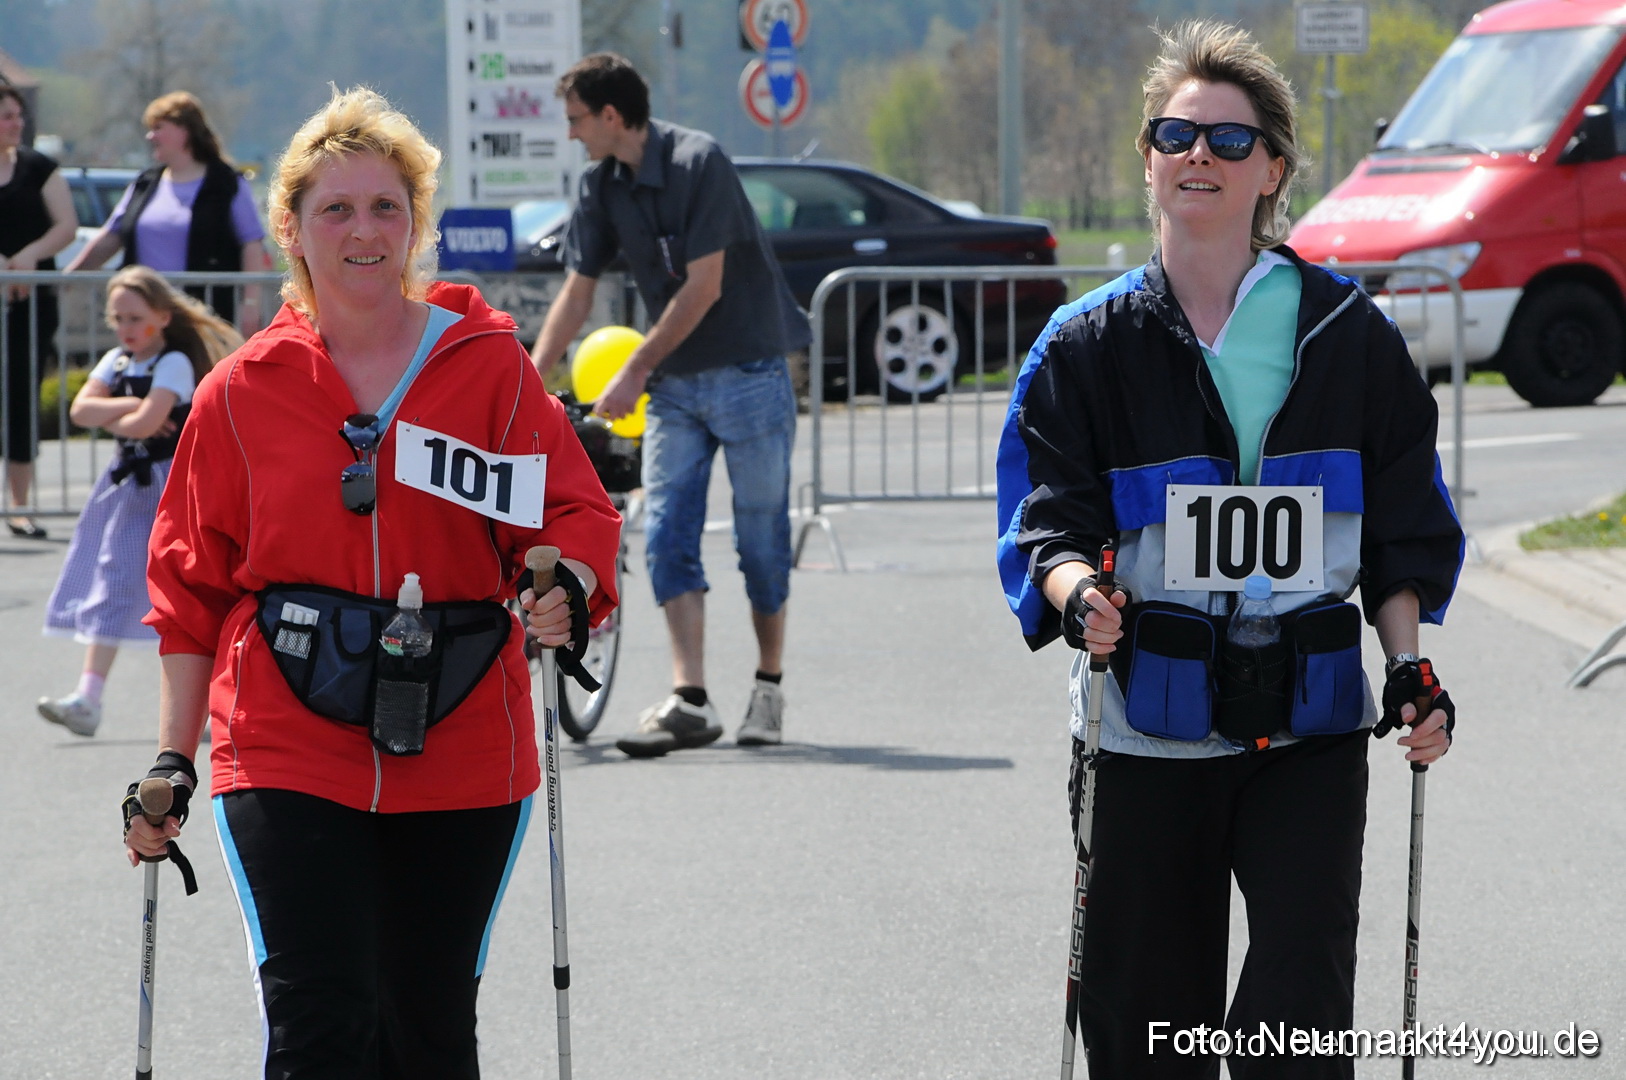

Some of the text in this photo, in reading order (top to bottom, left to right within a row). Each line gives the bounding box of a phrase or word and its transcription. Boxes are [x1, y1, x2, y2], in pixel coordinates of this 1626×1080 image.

[424, 437, 513, 514] 101
[1187, 495, 1302, 580] 100
[547, 744, 556, 773] pole
[549, 776, 557, 832] trekking
[145, 924, 153, 943] pole
[1071, 862, 1088, 978] FLASH
[144, 945, 153, 984] trekking
